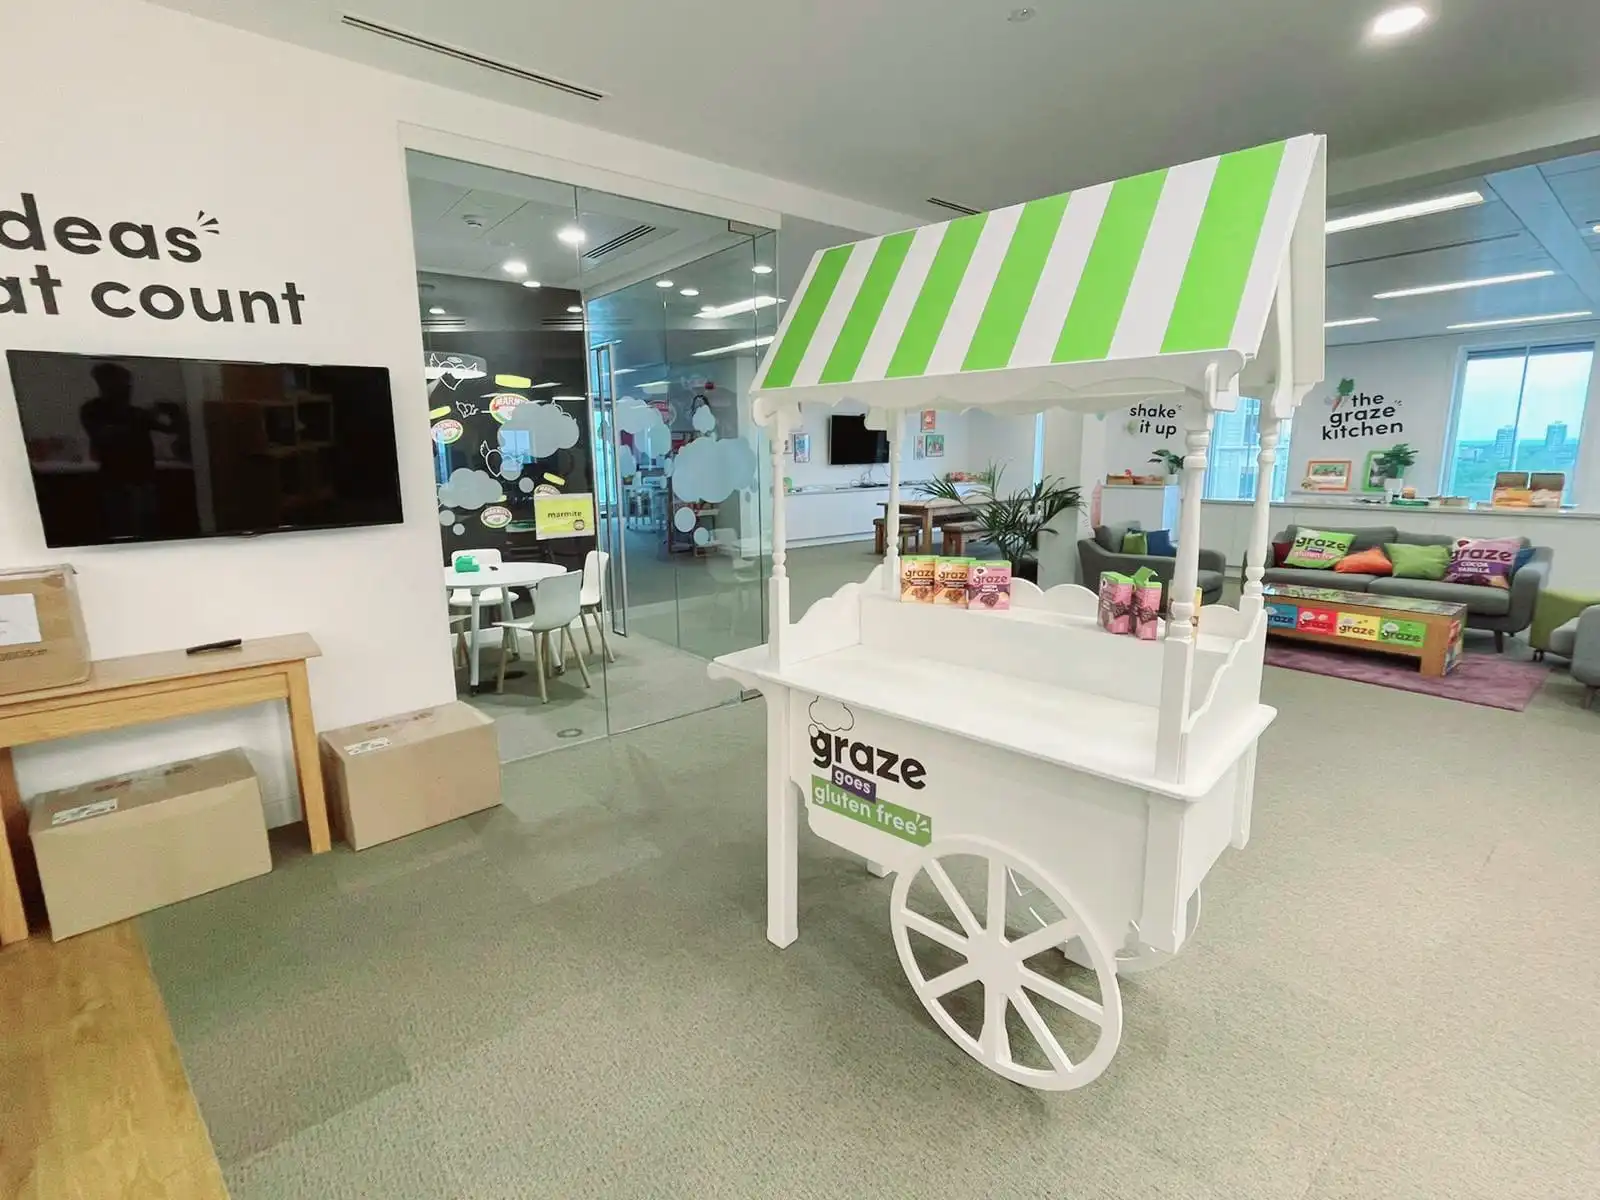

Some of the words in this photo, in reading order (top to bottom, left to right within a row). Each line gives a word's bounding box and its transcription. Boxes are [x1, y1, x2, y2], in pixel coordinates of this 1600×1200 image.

[91, 281, 305, 325] count
[1351, 392, 1384, 407] the
[1129, 403, 1176, 418] shake
[1329, 406, 1396, 428] graze
[1140, 419, 1151, 433] it
[1155, 424, 1177, 439] up
[1322, 421, 1403, 440] kitchen
[1295, 537, 1347, 552] graze
[1450, 548, 1513, 562] graze
[973, 574, 1008, 585] graze
[1338, 623, 1376, 637] graze
[1381, 629, 1421, 643] graze
[809, 729, 927, 790] graze
[834, 769, 871, 794] goes
[814, 783, 871, 819] gluten
[875, 804, 917, 835] free
